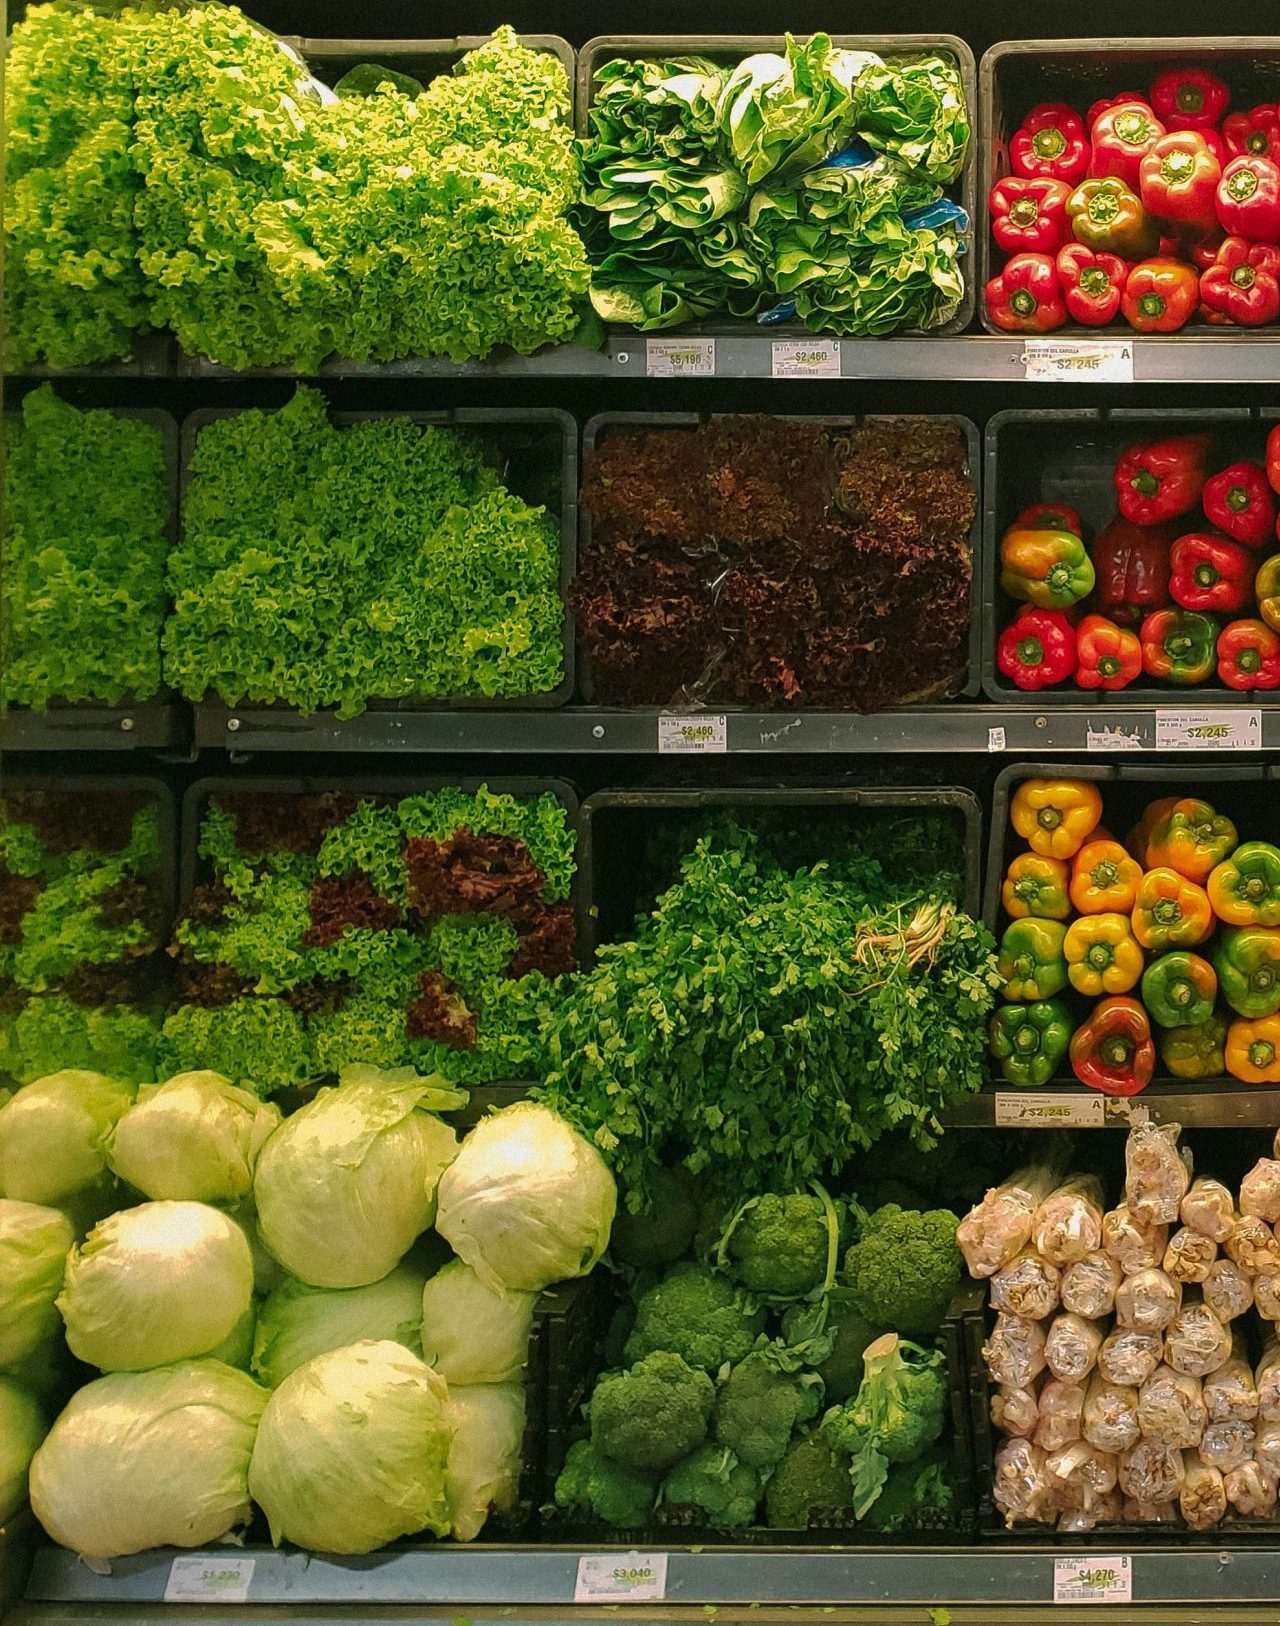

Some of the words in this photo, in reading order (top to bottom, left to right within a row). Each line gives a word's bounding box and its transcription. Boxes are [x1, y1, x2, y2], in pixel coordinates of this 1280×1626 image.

[795, 351, 827, 362] $2,460
[1121, 349, 1130, 359] A
[1249, 717, 1258, 727] A
[681, 726, 713, 737] $2,460
[1187, 728, 1229, 740] $2,245
[1092, 1100, 1101, 1109] A
[1029, 1107, 1071, 1117] $2,245
[1080, 1569, 1115, 1584] $4,270
